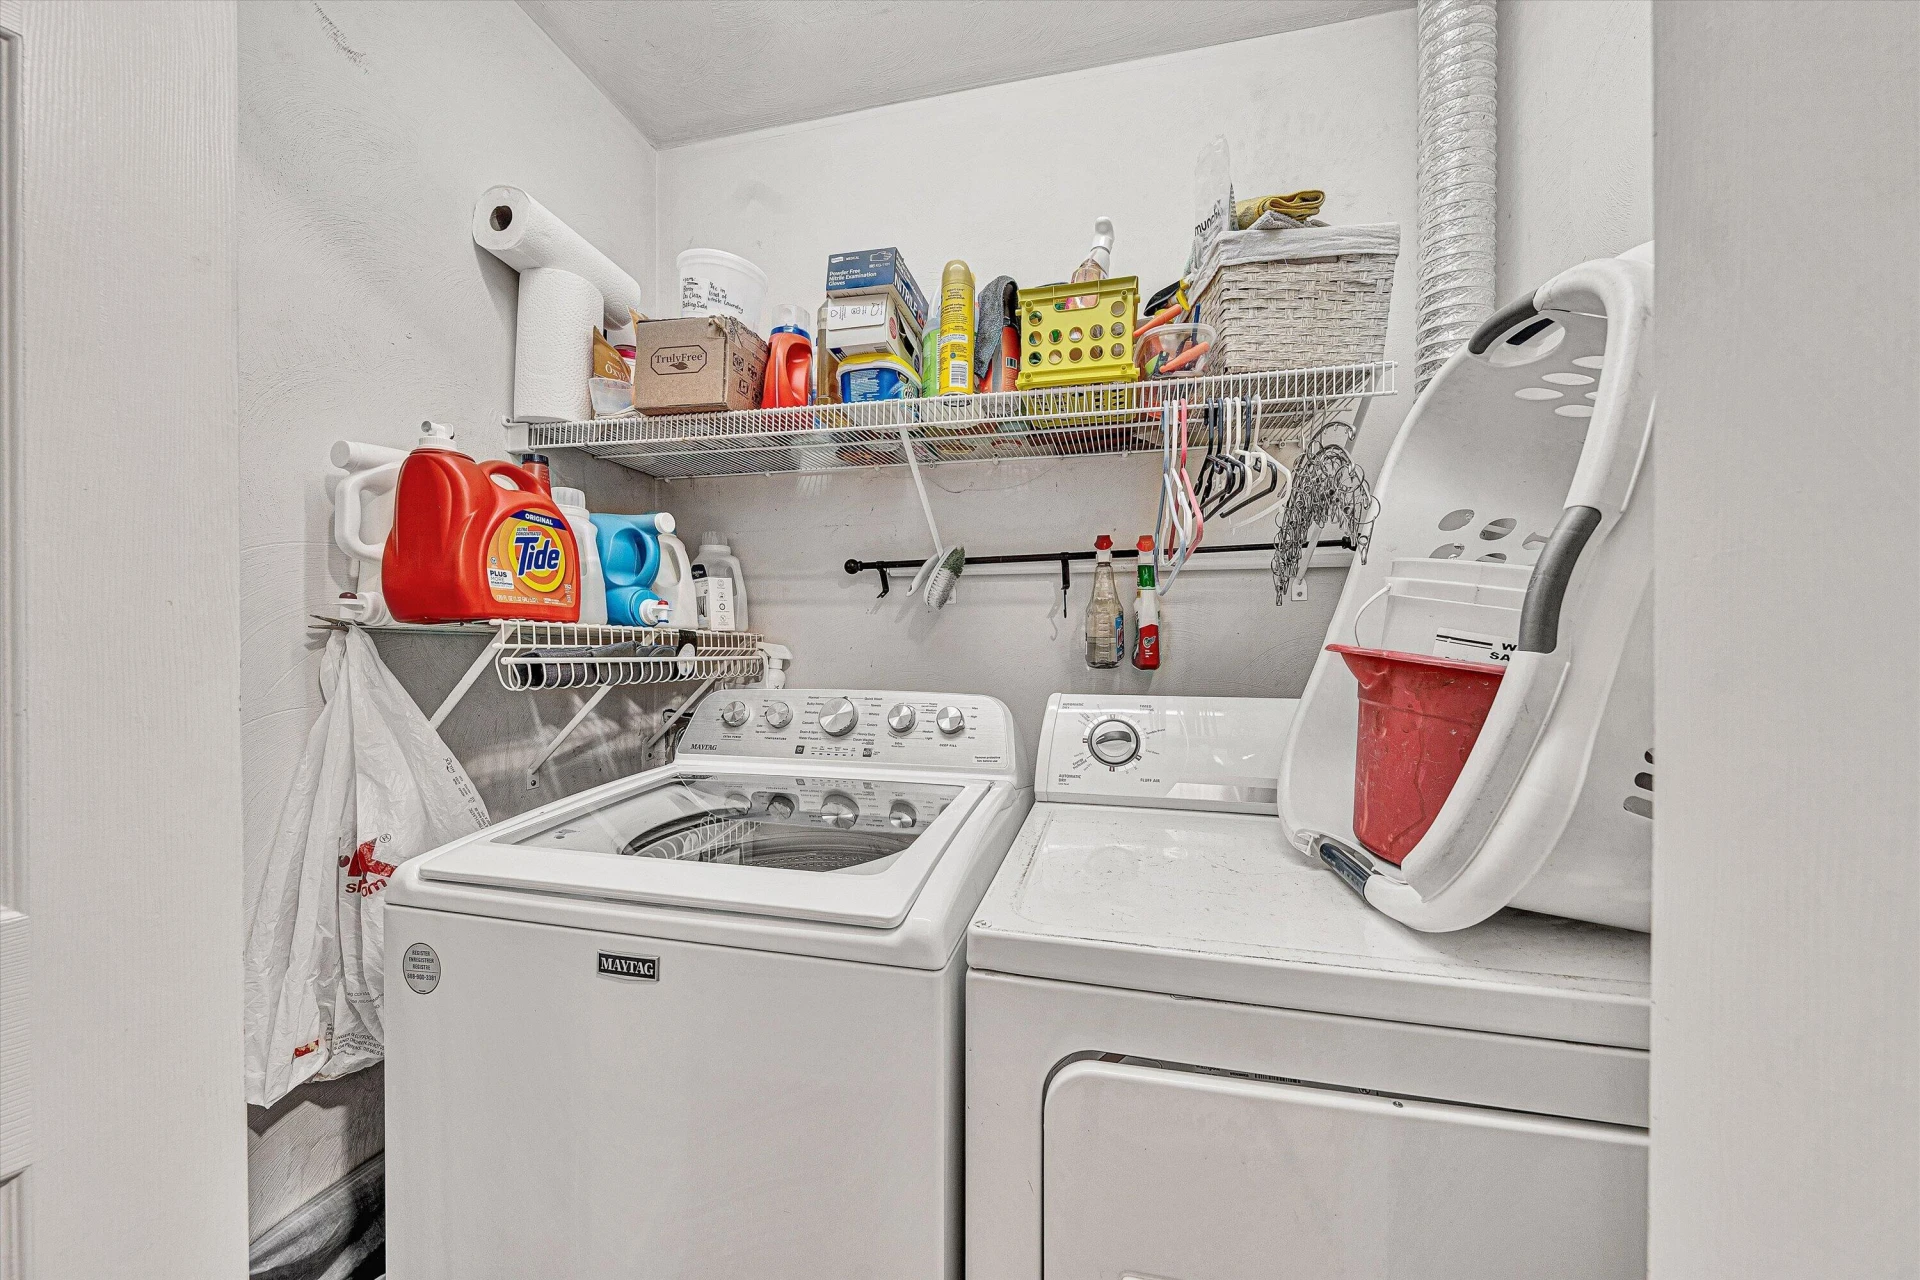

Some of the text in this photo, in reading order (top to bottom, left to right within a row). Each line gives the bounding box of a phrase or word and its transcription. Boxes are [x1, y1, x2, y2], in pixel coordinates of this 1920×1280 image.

[845, 272, 877, 280] Examination
[894, 272, 918, 317] NITRILE
[655, 352, 703, 364] TrulyFree
[525, 513, 553, 526] ORIGINAL
[514, 536, 561, 577] Tide
[489, 570, 507, 578] PLUS
[690, 743, 718, 751] MAYTAG
[600, 956, 654, 976] MAYTAG
